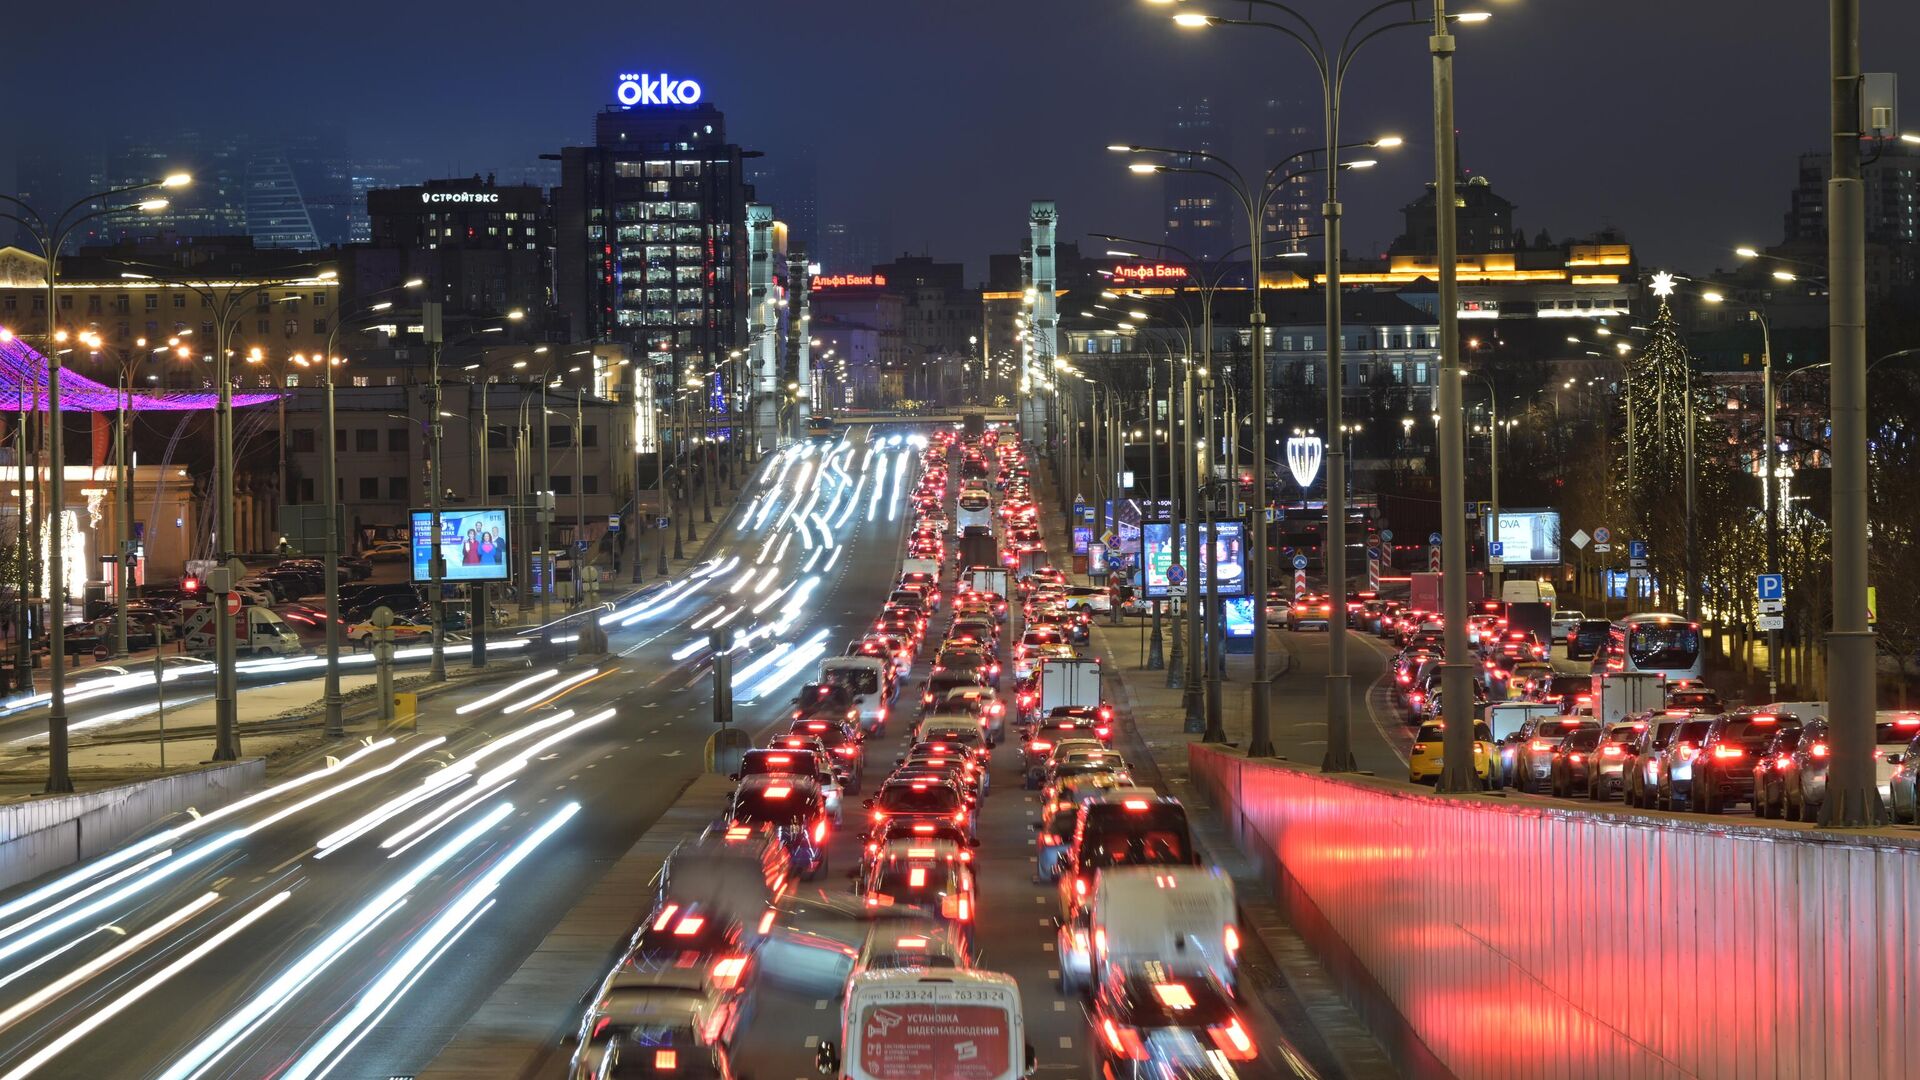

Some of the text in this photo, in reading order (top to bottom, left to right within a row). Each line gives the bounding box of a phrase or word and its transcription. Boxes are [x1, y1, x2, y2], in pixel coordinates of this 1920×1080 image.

[431, 192, 499, 203] СТРОЙТЭКС
[1114, 265, 1187, 280] Альфа Банк
[812, 274, 873, 289] Альфа Банк
[1492, 543, 1501, 555] P
[1634, 543, 1644, 556] P
[1764, 577, 1778, 597] P
[906, 1014, 959, 1024] УСТАНОВКА
[907, 1025, 1000, 1037] ВИДЕОНАБЛЮДЕНИЯ
